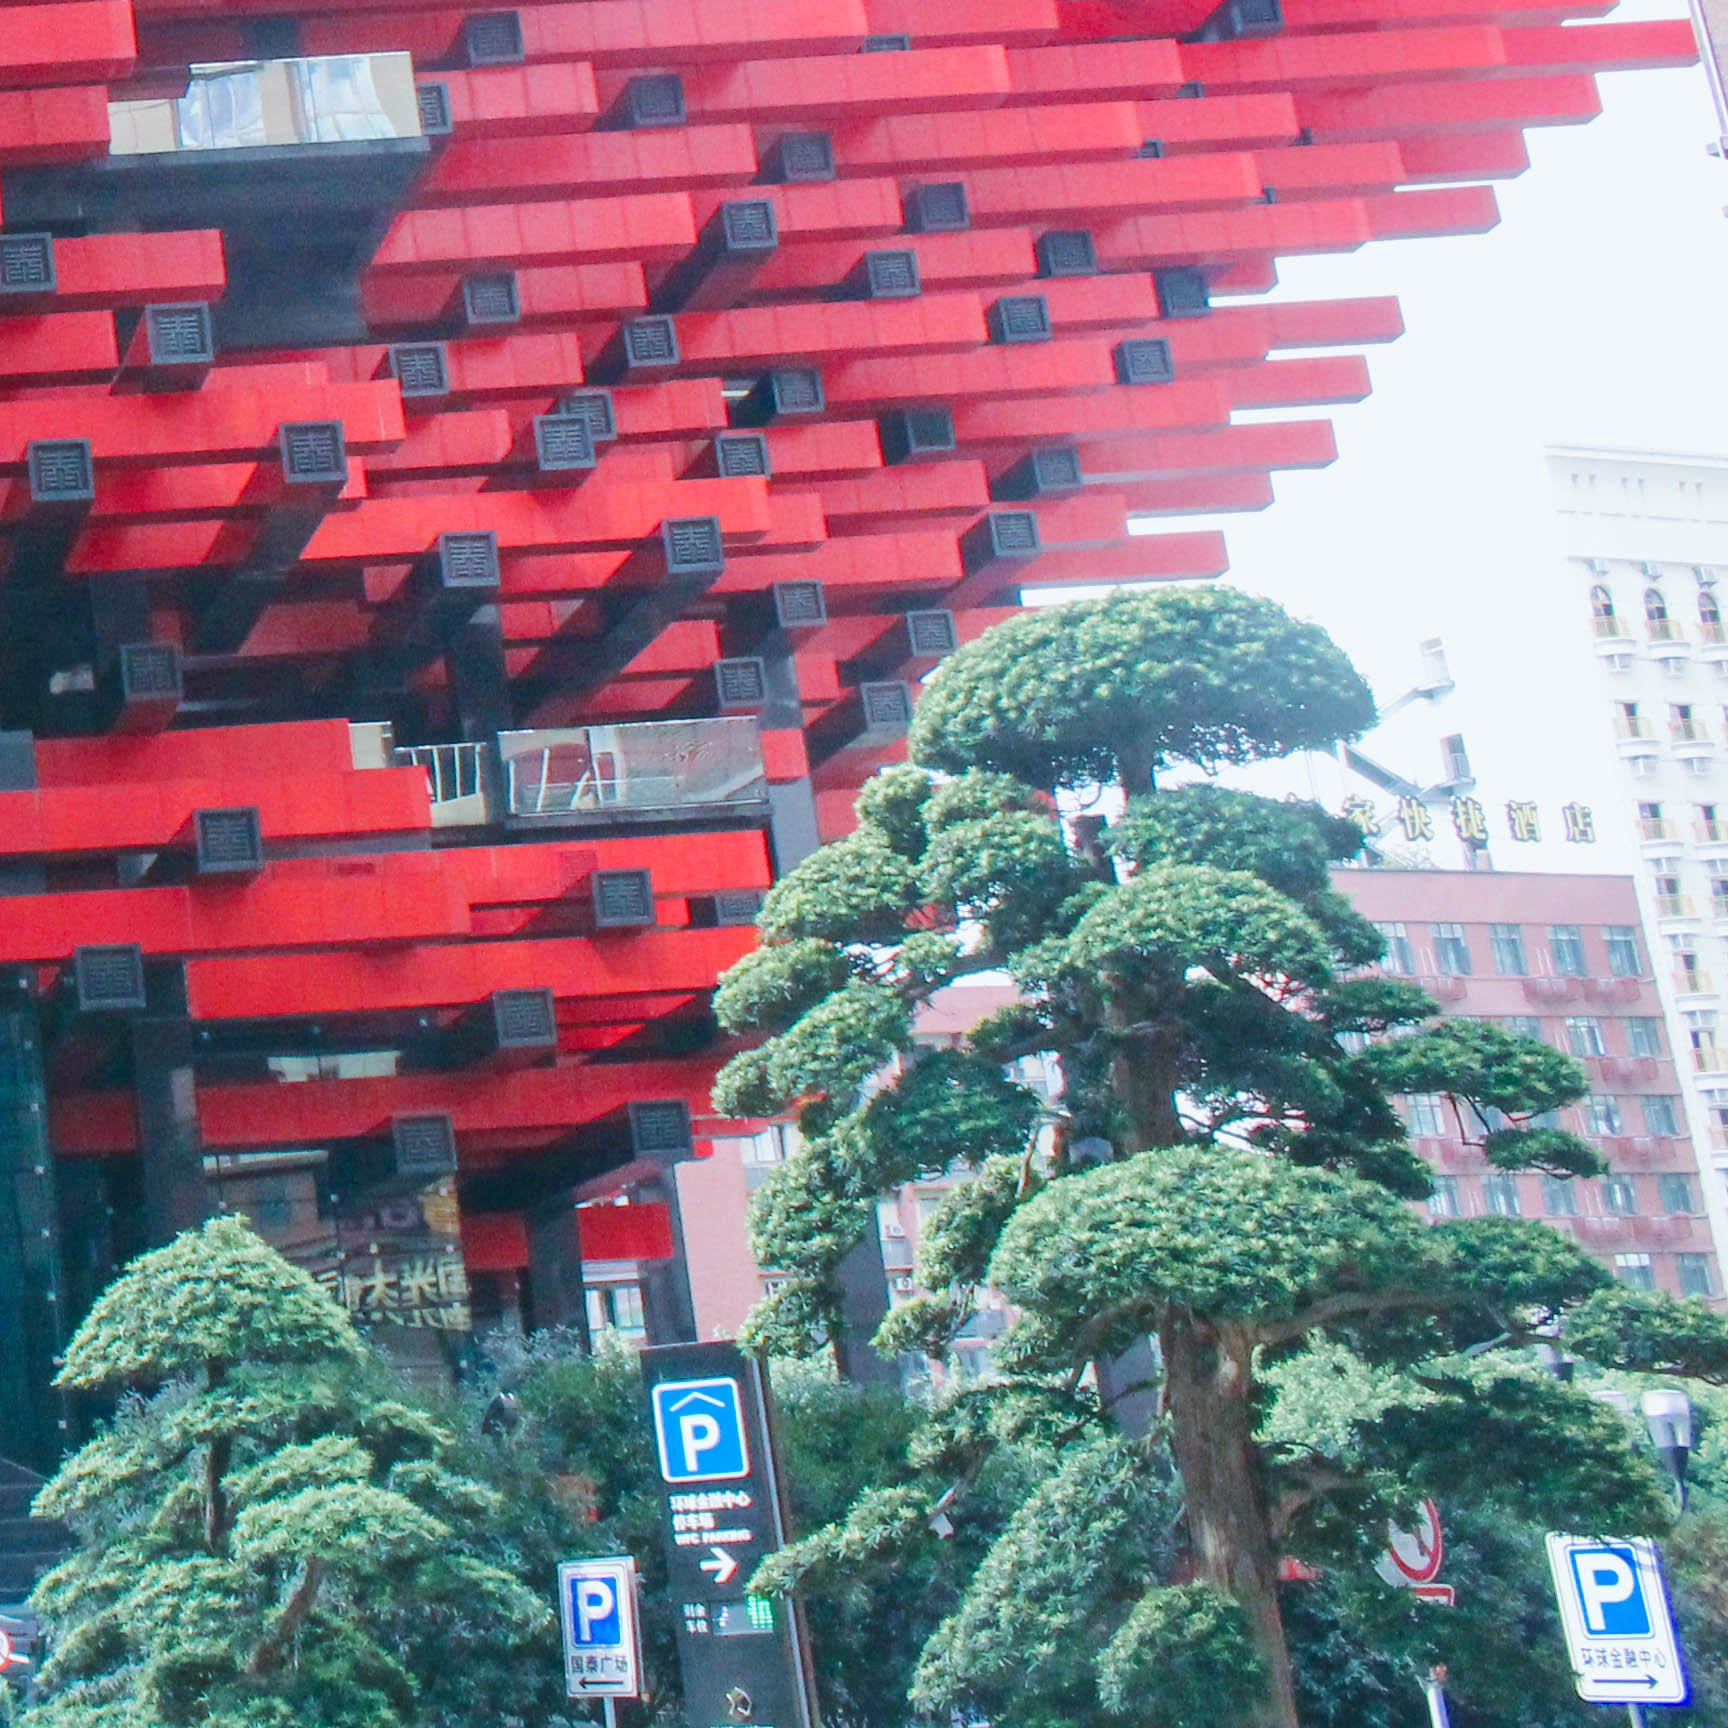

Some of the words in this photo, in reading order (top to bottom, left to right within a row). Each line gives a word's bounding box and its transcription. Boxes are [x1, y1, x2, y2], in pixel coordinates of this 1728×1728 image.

[680, 1414, 721, 1472] P
[669, 1489, 752, 1512] 环球金融中心
[672, 1511, 716, 1532] 停车场
[702, 1527, 754, 1545] PARKING
[1574, 1553, 1635, 1631] P
[576, 1580, 615, 1642] P
[570, 1653, 629, 1674] 国泰广场
[1580, 1647, 1668, 1669] 环球金融中心
